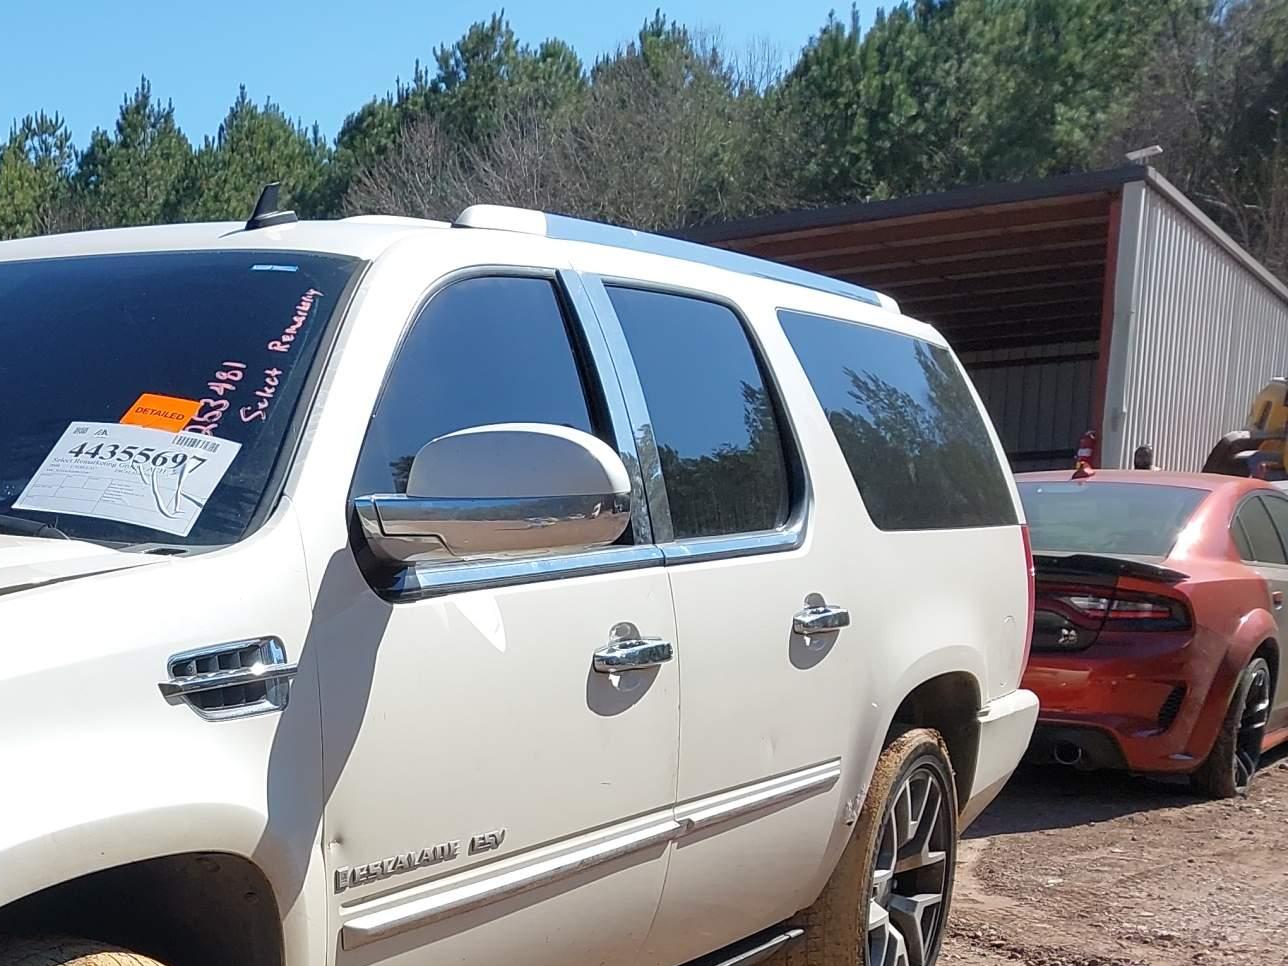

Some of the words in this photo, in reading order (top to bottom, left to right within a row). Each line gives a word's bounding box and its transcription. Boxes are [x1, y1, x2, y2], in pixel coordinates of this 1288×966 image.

[134, 405, 185, 422] DETAILED
[68, 441, 208, 474] 44355697
[350, 840, 461, 888] ESCALADE
[468, 828, 506, 856] ESV
